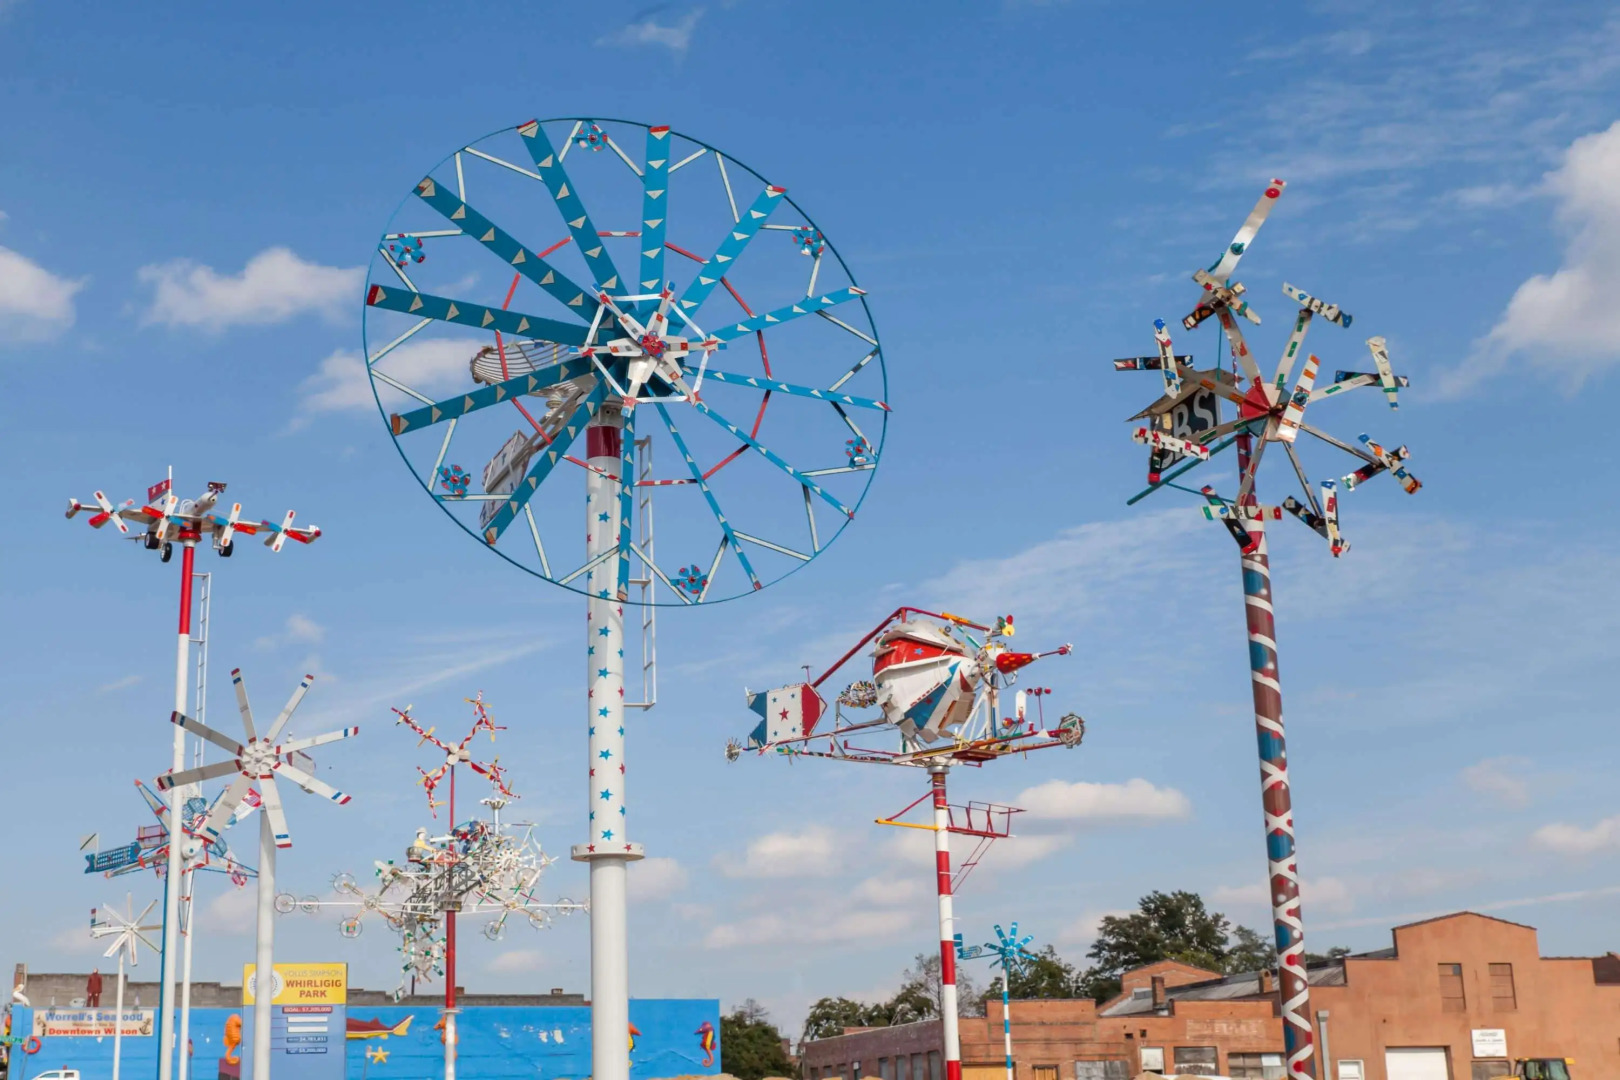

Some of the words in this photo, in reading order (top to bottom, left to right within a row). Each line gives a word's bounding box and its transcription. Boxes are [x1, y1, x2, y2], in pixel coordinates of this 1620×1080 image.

[286, 979, 342, 988] WHIRLIGIG
[299, 990, 327, 998] PARK
[45, 1012, 93, 1021] Worrell's
[96, 1012, 143, 1021] Seaood
